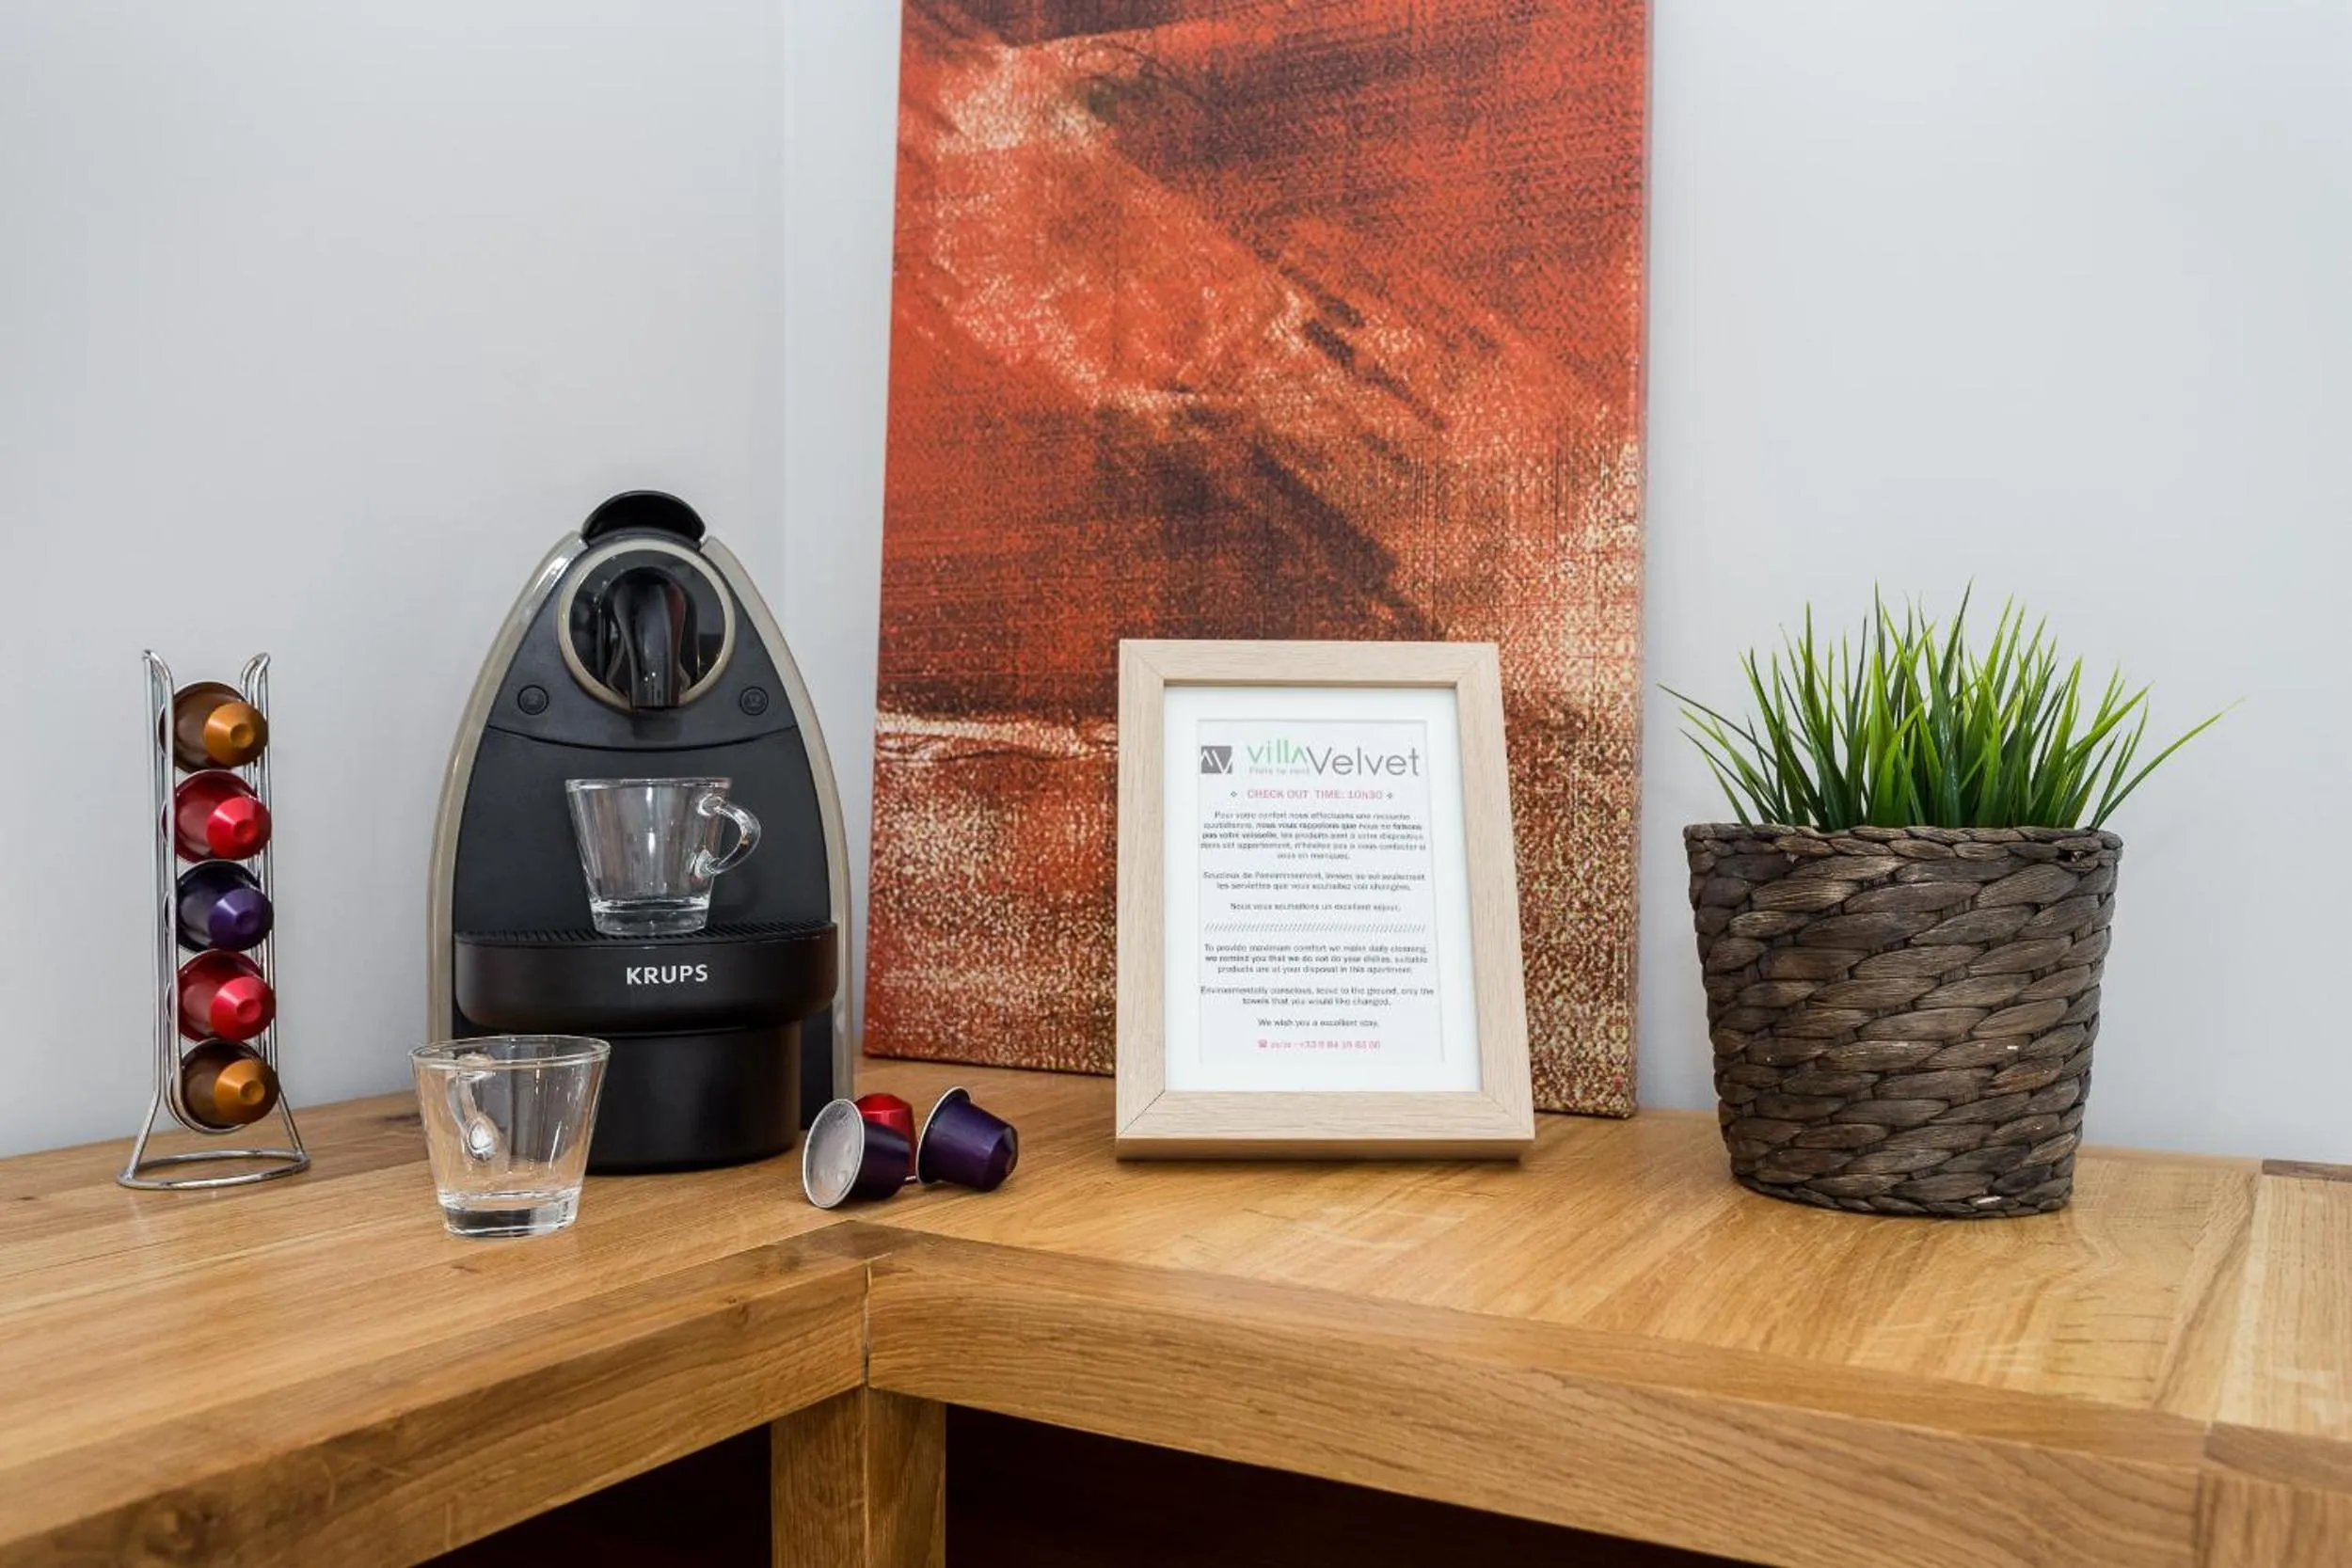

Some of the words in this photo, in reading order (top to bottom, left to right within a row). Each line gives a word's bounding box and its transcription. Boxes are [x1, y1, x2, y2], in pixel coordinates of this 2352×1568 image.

[1306, 746, 1420, 776] Velvet
[1247, 789, 1283, 799] CHECK
[1286, 789, 1309, 799] OUT
[1315, 789, 1345, 800] TIME:
[626, 963, 708, 985] KRUPS
